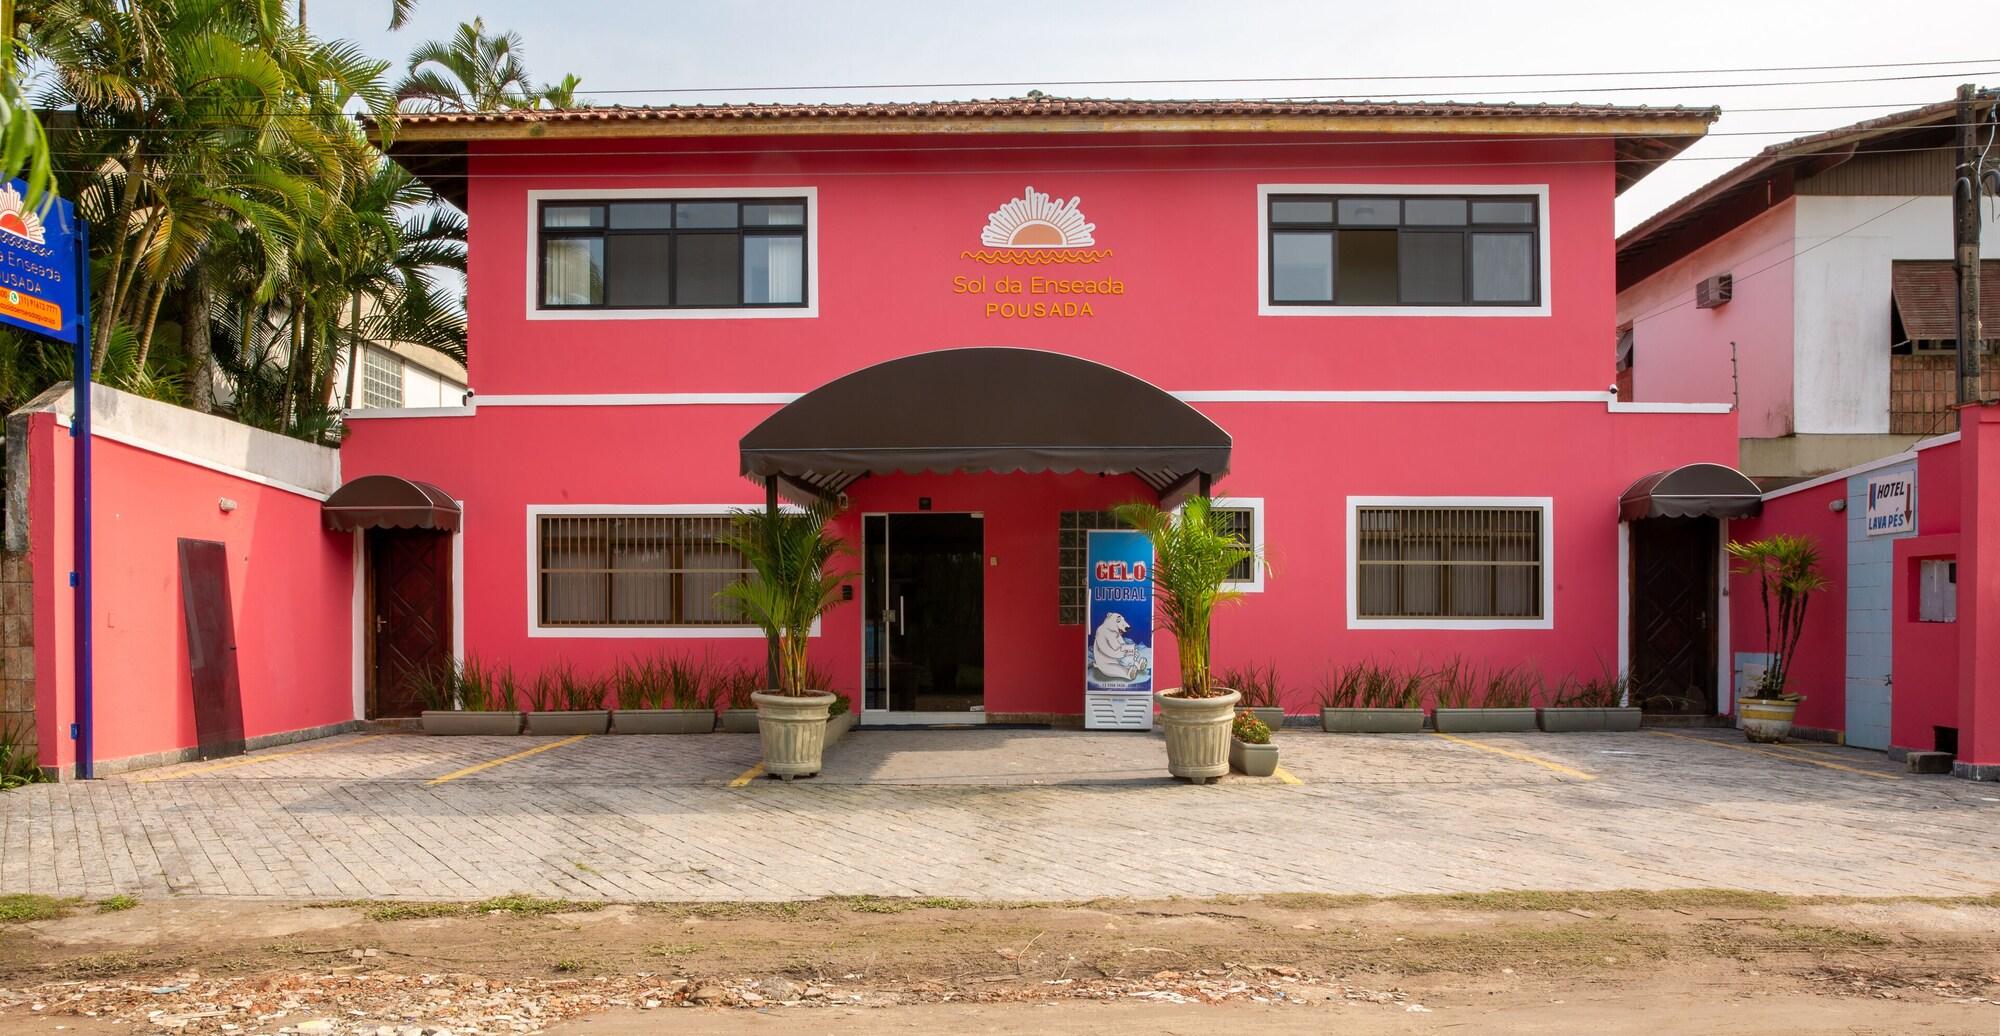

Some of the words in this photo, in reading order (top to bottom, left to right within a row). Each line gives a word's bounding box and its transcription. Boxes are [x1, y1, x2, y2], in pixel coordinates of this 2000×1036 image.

[8, 251, 61, 282] Enseada
[0, 271, 41, 294] USADA
[953, 275, 986, 294] Sol
[995, 275, 1023, 294] da
[1031, 275, 1125, 294] Enseada
[986, 302, 1094, 318] POUSADA
[1877, 481, 1904, 499] HOTEL
[1868, 515, 1887, 530] LAVA
[1888, 507, 1904, 528] PÉS
[1095, 560, 1146, 581] GELO
[1095, 587, 1146, 601] LITORAL
